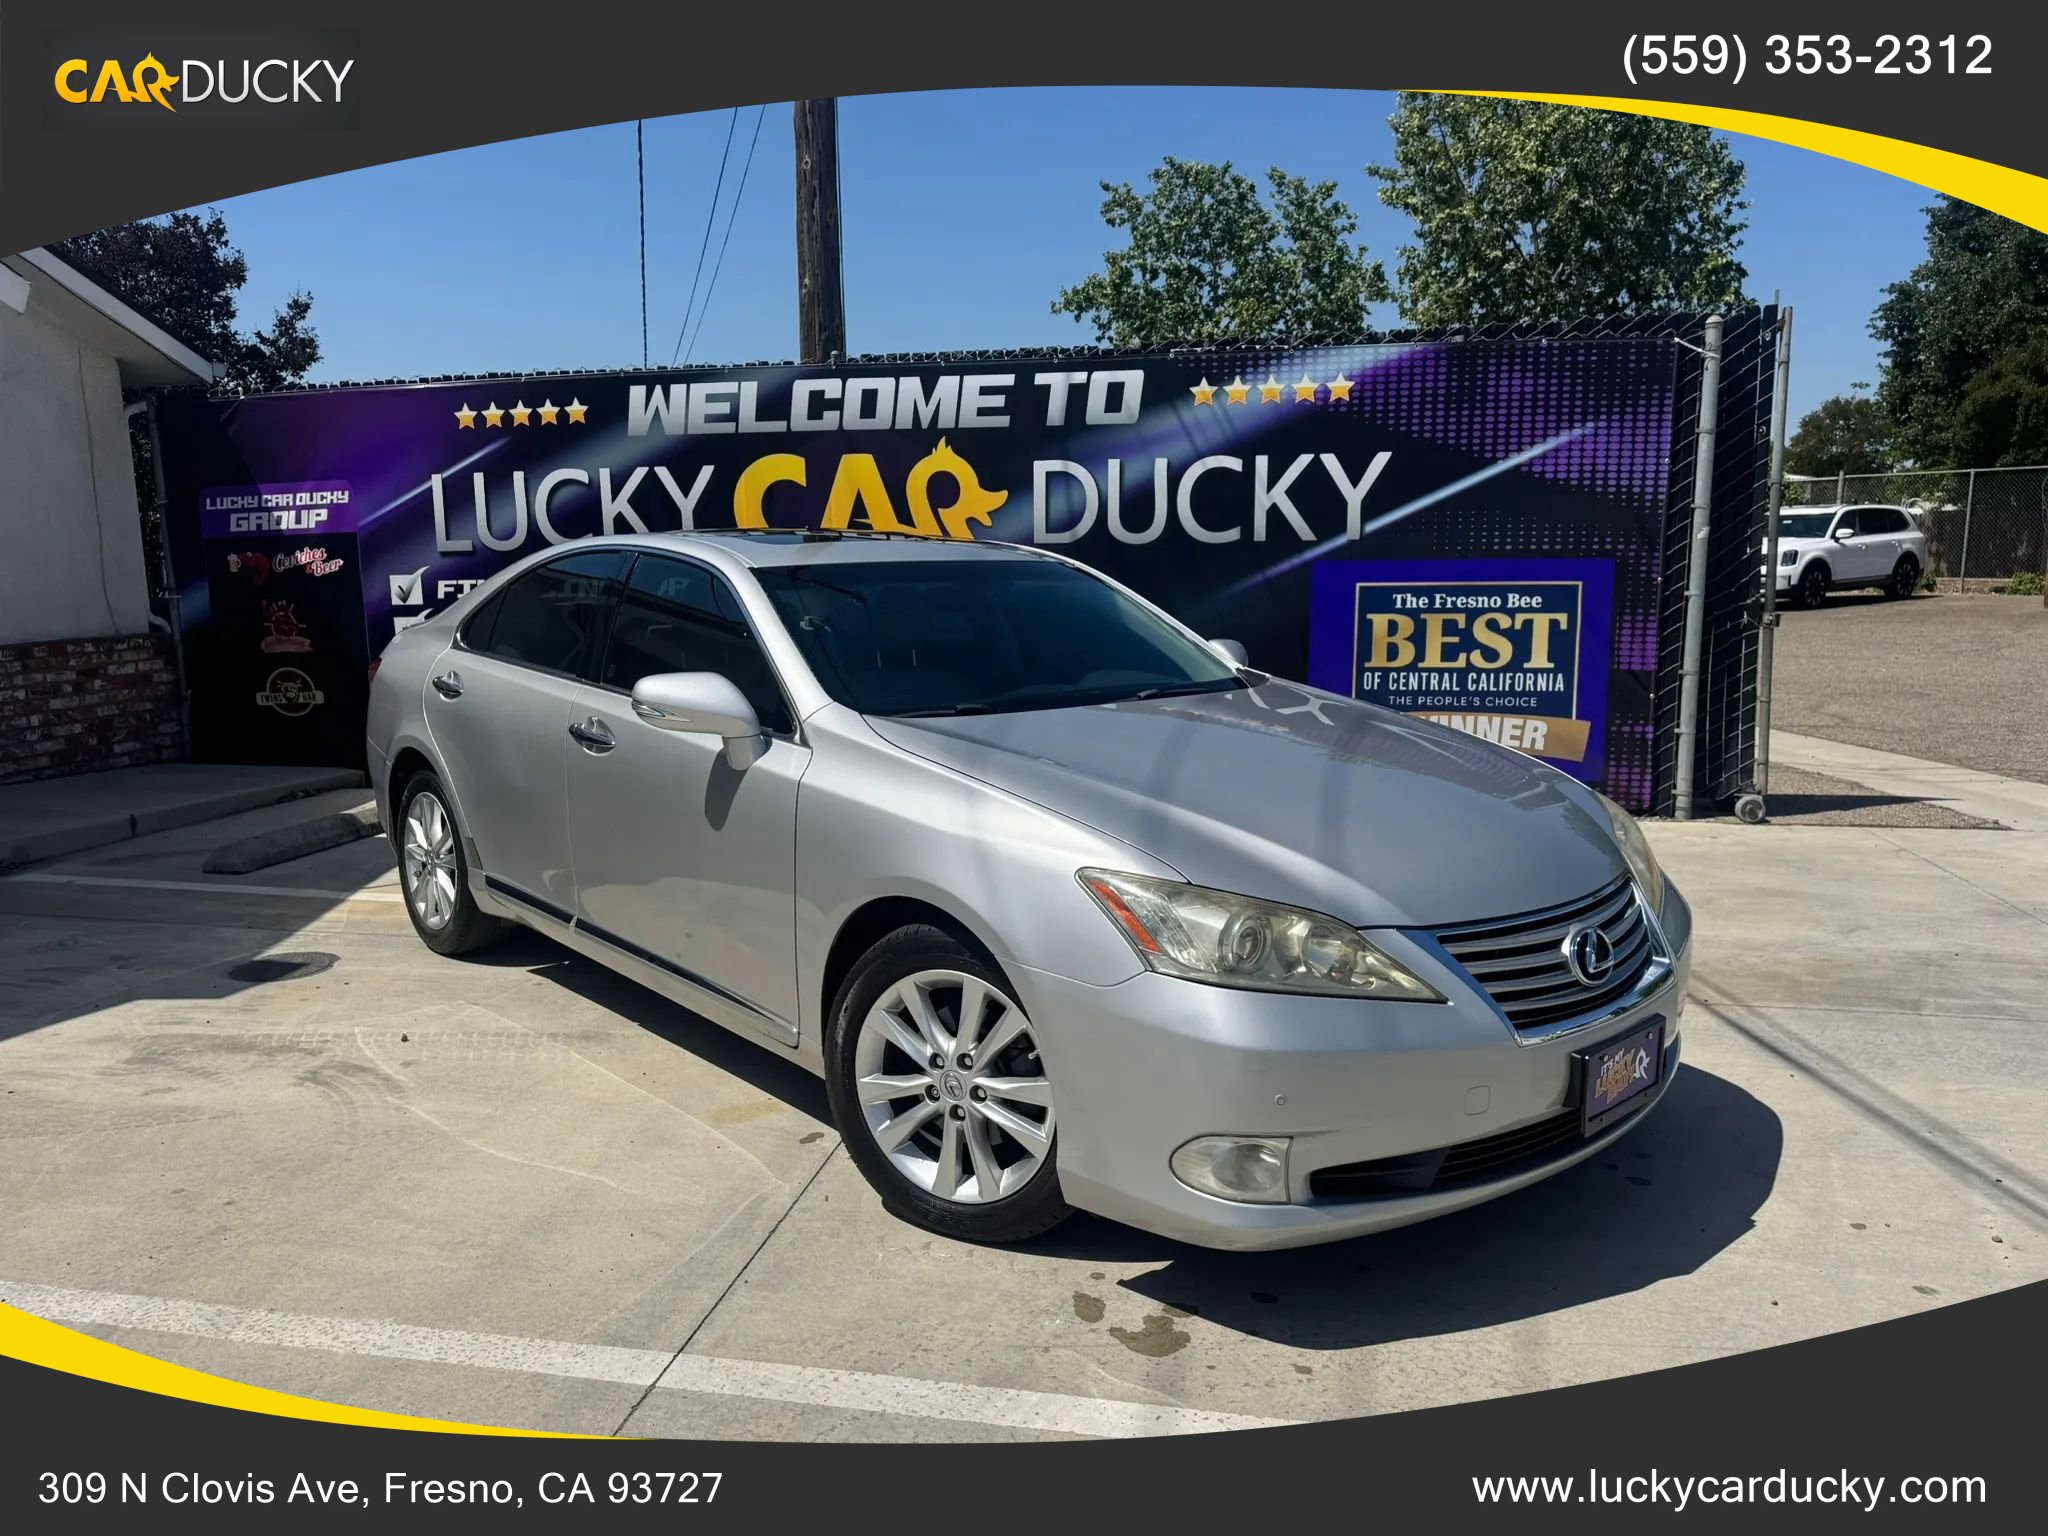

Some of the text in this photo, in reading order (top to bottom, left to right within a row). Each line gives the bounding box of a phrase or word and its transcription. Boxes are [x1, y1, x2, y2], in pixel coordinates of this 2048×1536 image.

[626, 369, 1145, 437] WELCOME TO
[206, 490, 349, 510] LUCKY CAR DUCKY
[430, 464, 715, 553] LUCKY
[1032, 450, 1393, 545] DUCKY
[230, 508, 328, 532] GROUP
[311, 558, 343, 577] Beer
[1392, 593, 1543, 609] The Fresno Bee
[1363, 612, 1569, 669] BEST
[1363, 671, 1565, 692] OF CENTRAL CALIFORNIA
[1388, 695, 1538, 707] THE PEOPLE'S CHOICE
